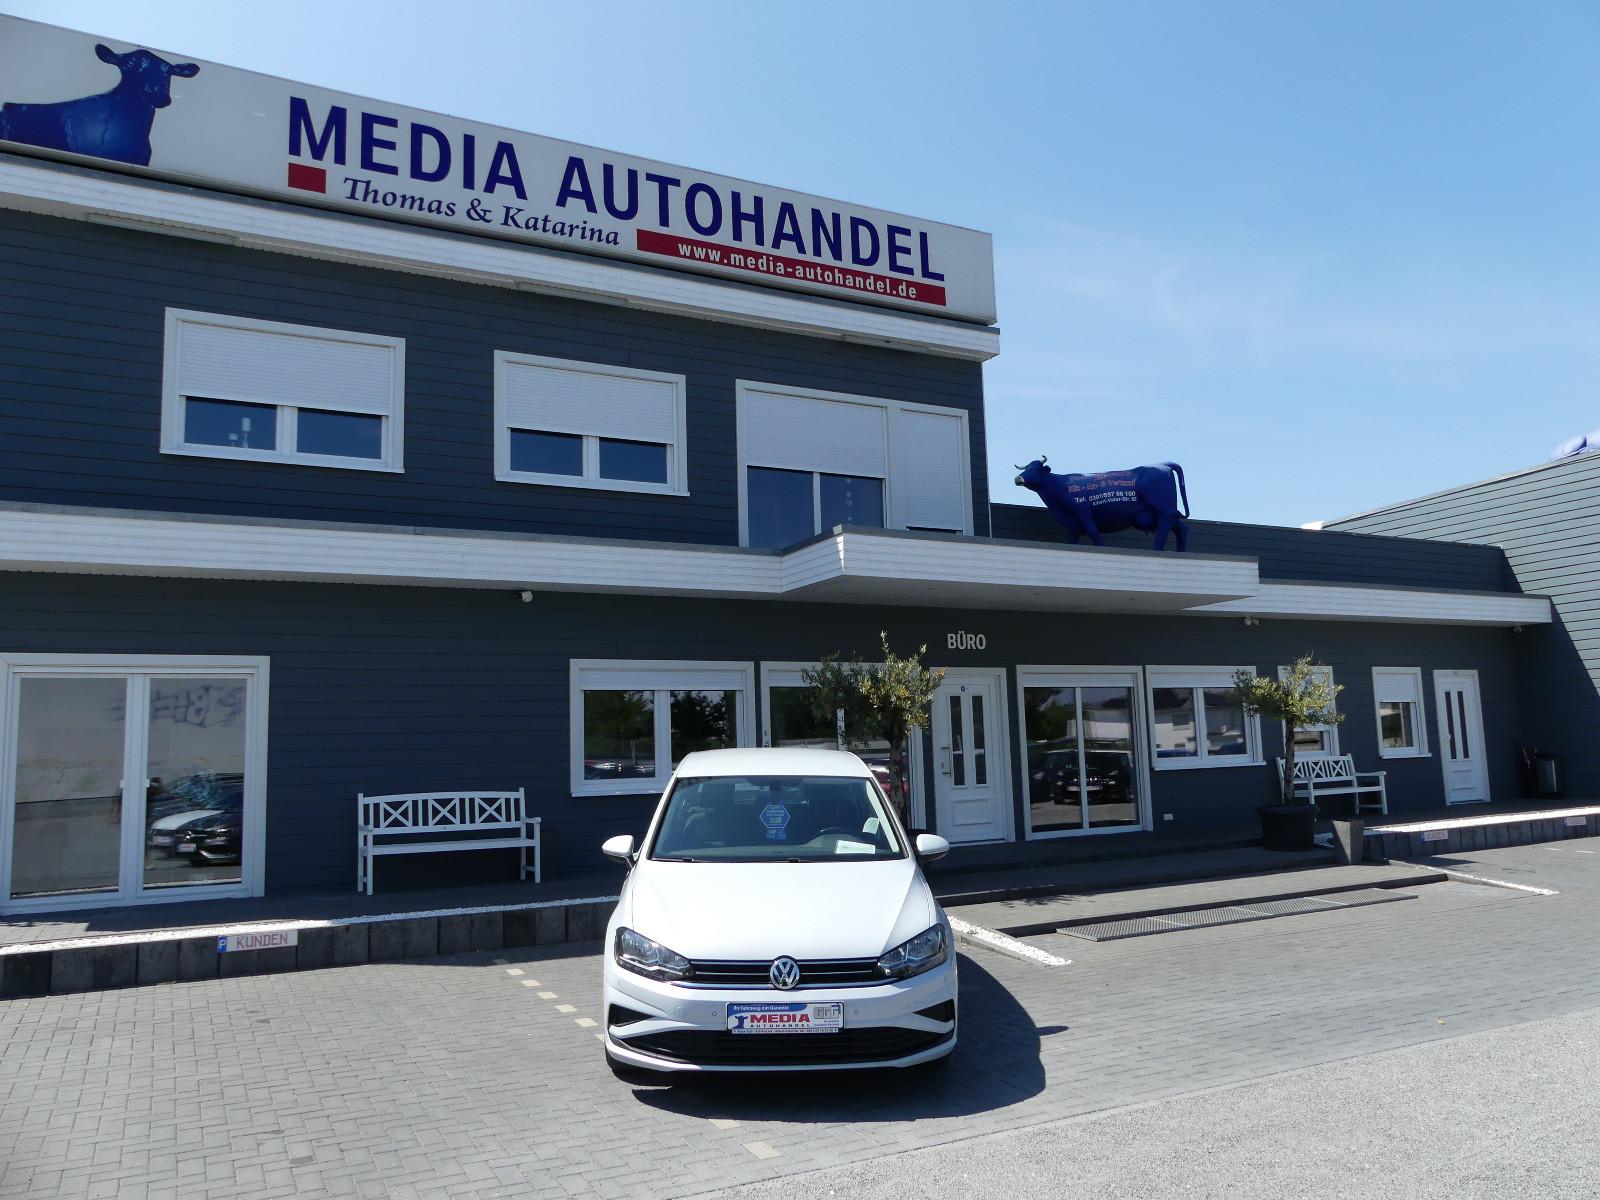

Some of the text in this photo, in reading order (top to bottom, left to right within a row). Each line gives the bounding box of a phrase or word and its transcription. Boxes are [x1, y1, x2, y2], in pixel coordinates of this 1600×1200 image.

[288, 96, 944, 281] MEDIA AUTOHANDEL
[344, 176, 620, 246] Thomas & Katarina
[678, 243, 917, 299] www.media-autohandel.de
[947, 630, 986, 650] BÜRO
[236, 932, 289, 949] KUNDEN
[749, 1013, 811, 1023] MEDIA
